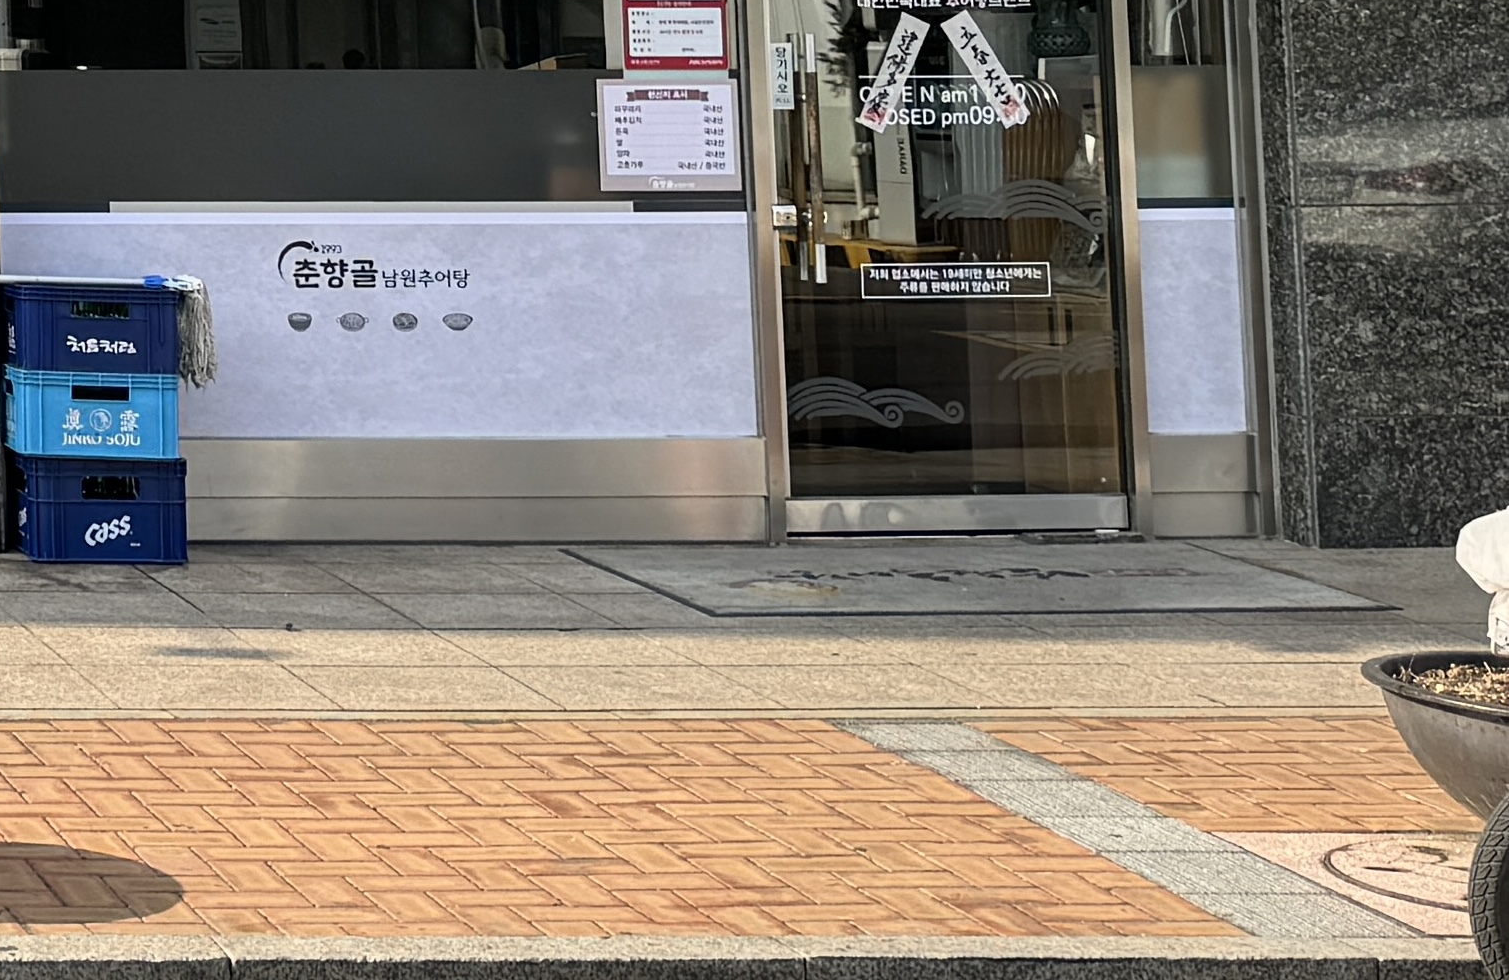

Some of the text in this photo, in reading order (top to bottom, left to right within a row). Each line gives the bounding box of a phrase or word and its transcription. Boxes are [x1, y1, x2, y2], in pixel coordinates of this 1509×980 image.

[776, 46, 788, 93] 당기시오
[859, 85, 934, 103] OEN
[293, 258, 470, 289] 춘향골 남원추어탕
[66, 335, 137, 354] 처음처럼
